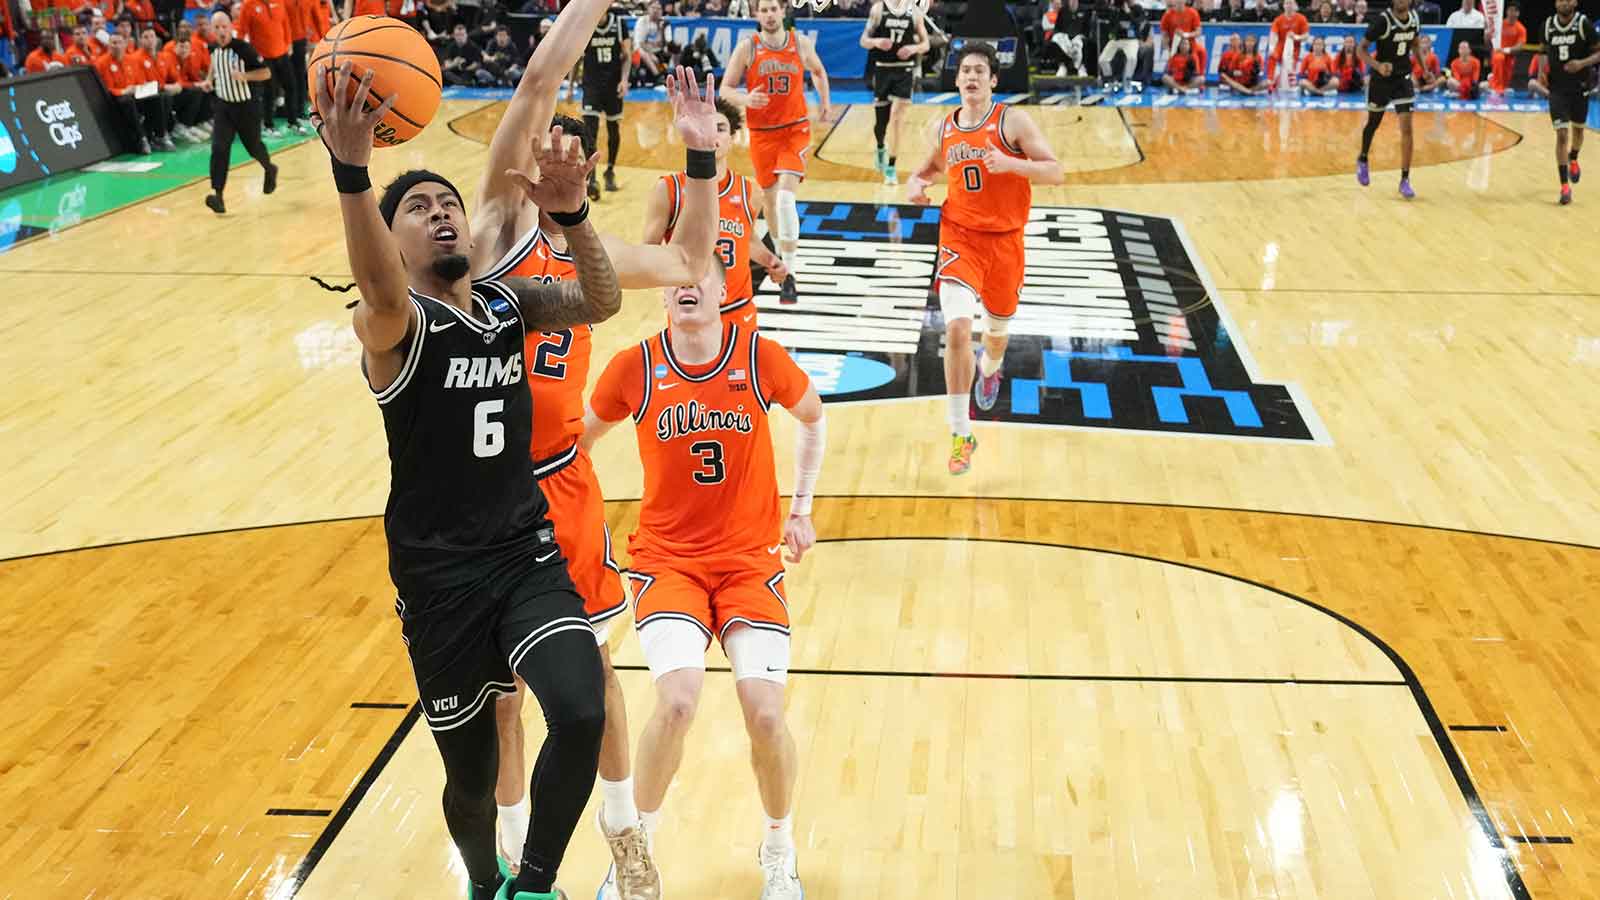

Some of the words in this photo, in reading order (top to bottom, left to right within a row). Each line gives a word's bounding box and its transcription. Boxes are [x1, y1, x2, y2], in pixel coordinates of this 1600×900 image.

[890, 29, 905, 43] 17
[596, 47, 612, 63] 15
[768, 75, 791, 95] 13
[36, 100, 75, 123] Great
[49, 122, 82, 149] Clips
[963, 165, 982, 192] 0
[714, 237, 736, 269] 3
[531, 327, 574, 381] 2
[443, 352, 522, 389] RAMS
[473, 399, 504, 458] 6
[656, 400, 752, 440] Illinois
[689, 440, 726, 485] 3
[432, 695, 458, 712] VCU
